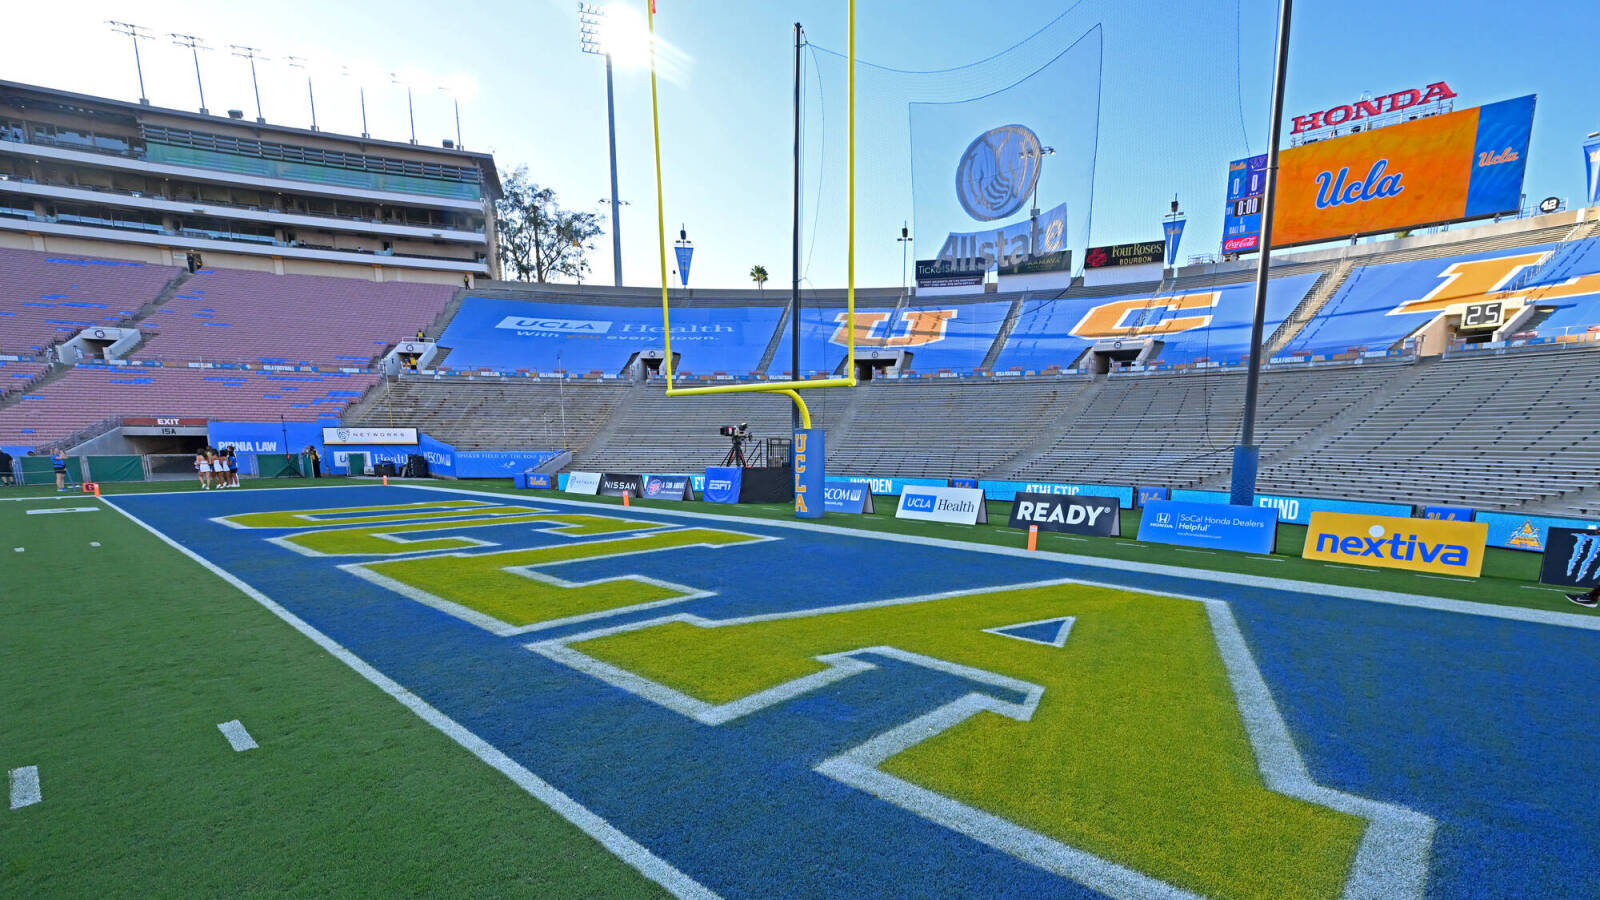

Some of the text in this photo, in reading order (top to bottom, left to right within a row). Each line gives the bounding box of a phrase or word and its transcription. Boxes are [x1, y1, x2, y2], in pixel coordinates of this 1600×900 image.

[1290, 81, 1458, 135] HONDA
[1478, 147, 1519, 168] Ucla
[1233, 174, 1259, 195] 0 0
[1314, 159, 1405, 210] Ucla
[1237, 198, 1258, 216] 0:00
[1540, 198, 1558, 211] 42
[935, 219, 1065, 268] Allstate
[1111, 243, 1162, 258] Four Roses
[1120, 256, 1152, 265] BOURBON
[1467, 303, 1499, 325] 25
[515, 320, 733, 333] UCLA Health
[157, 418, 180, 426] EXIT
[255, 441, 277, 452] LAW
[374, 453, 409, 464] Healt
[795, 434, 808, 513] UCLA
[85, 483, 95, 491] G
[604, 481, 637, 490] NISSAN
[850, 478, 893, 493] ODEN
[824, 488, 850, 501] SCOM
[907, 496, 975, 513] UCLA Health
[1180, 514, 1265, 528] SoCal Honda Dealers
[1315, 532, 1469, 567] nextiva
[209, 498, 1438, 900] UCLA
